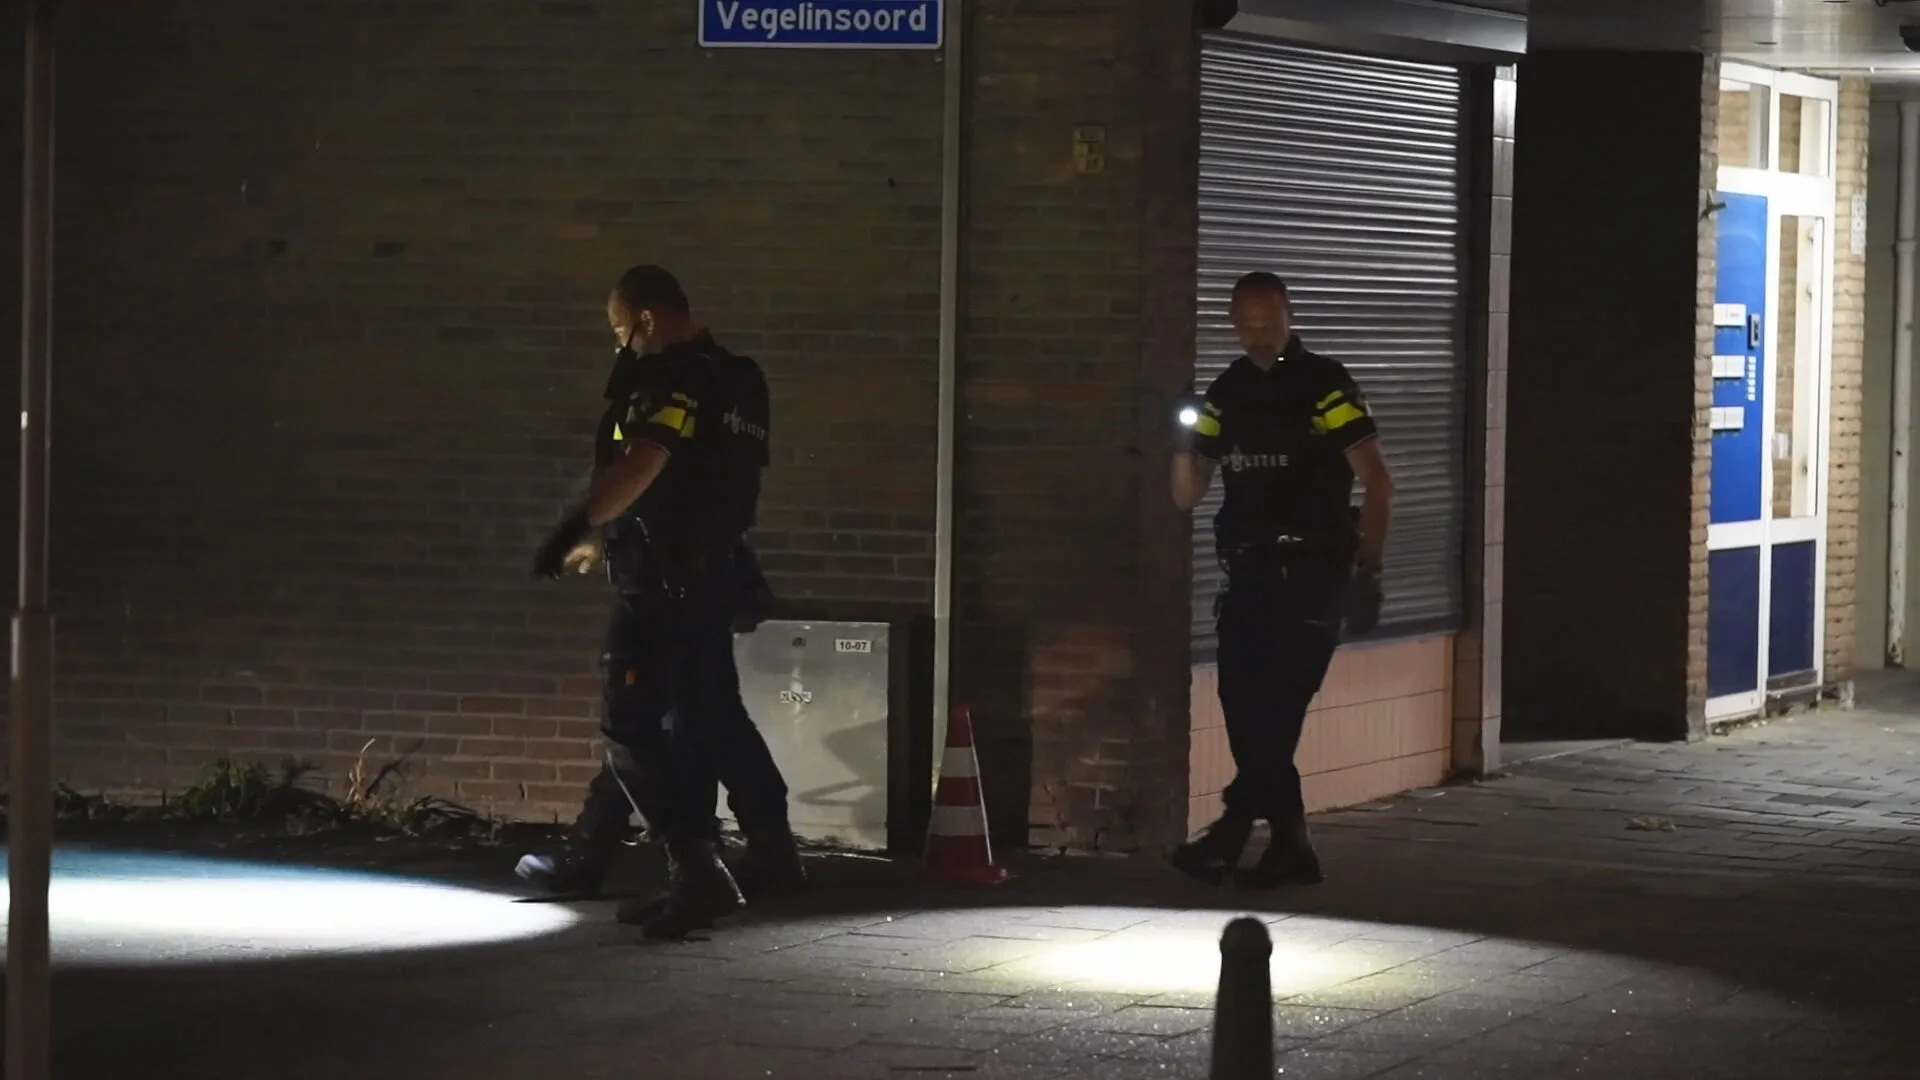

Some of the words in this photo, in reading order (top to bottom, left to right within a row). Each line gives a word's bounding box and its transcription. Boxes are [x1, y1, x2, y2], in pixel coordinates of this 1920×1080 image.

[717, 1, 928, 38] Vegelinsoord
[1221, 446, 1289, 473] POLITIE
[839, 641, 867, 650] 10-07
